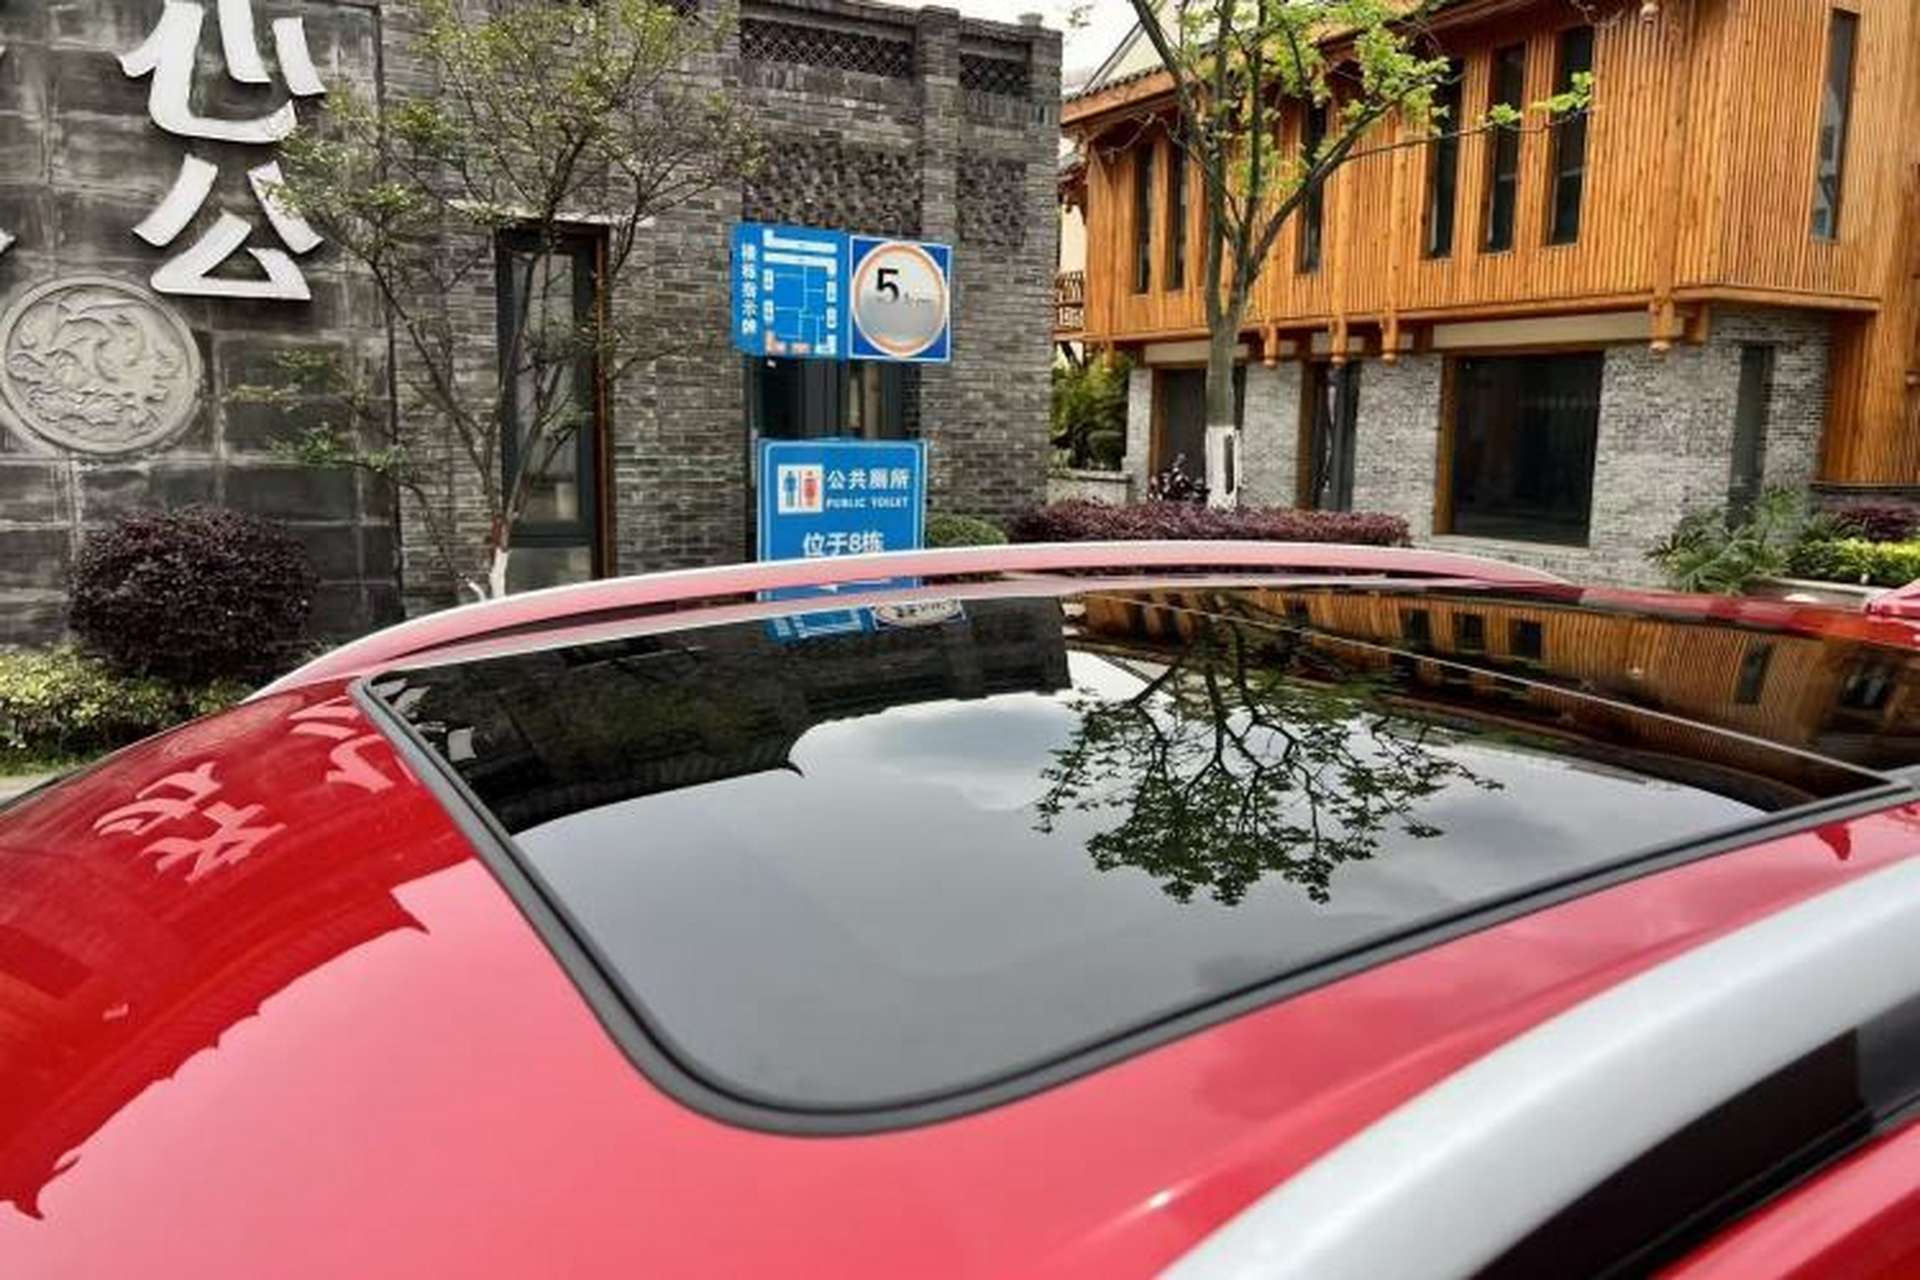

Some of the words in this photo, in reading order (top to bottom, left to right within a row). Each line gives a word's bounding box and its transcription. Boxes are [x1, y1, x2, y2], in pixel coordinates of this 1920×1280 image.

[827, 467, 911, 490] 公共厕所
[826, 497, 866, 508] PUBLIC
[871, 496, 909, 508] TOILET
[803, 531, 885, 558] 位于8栋
